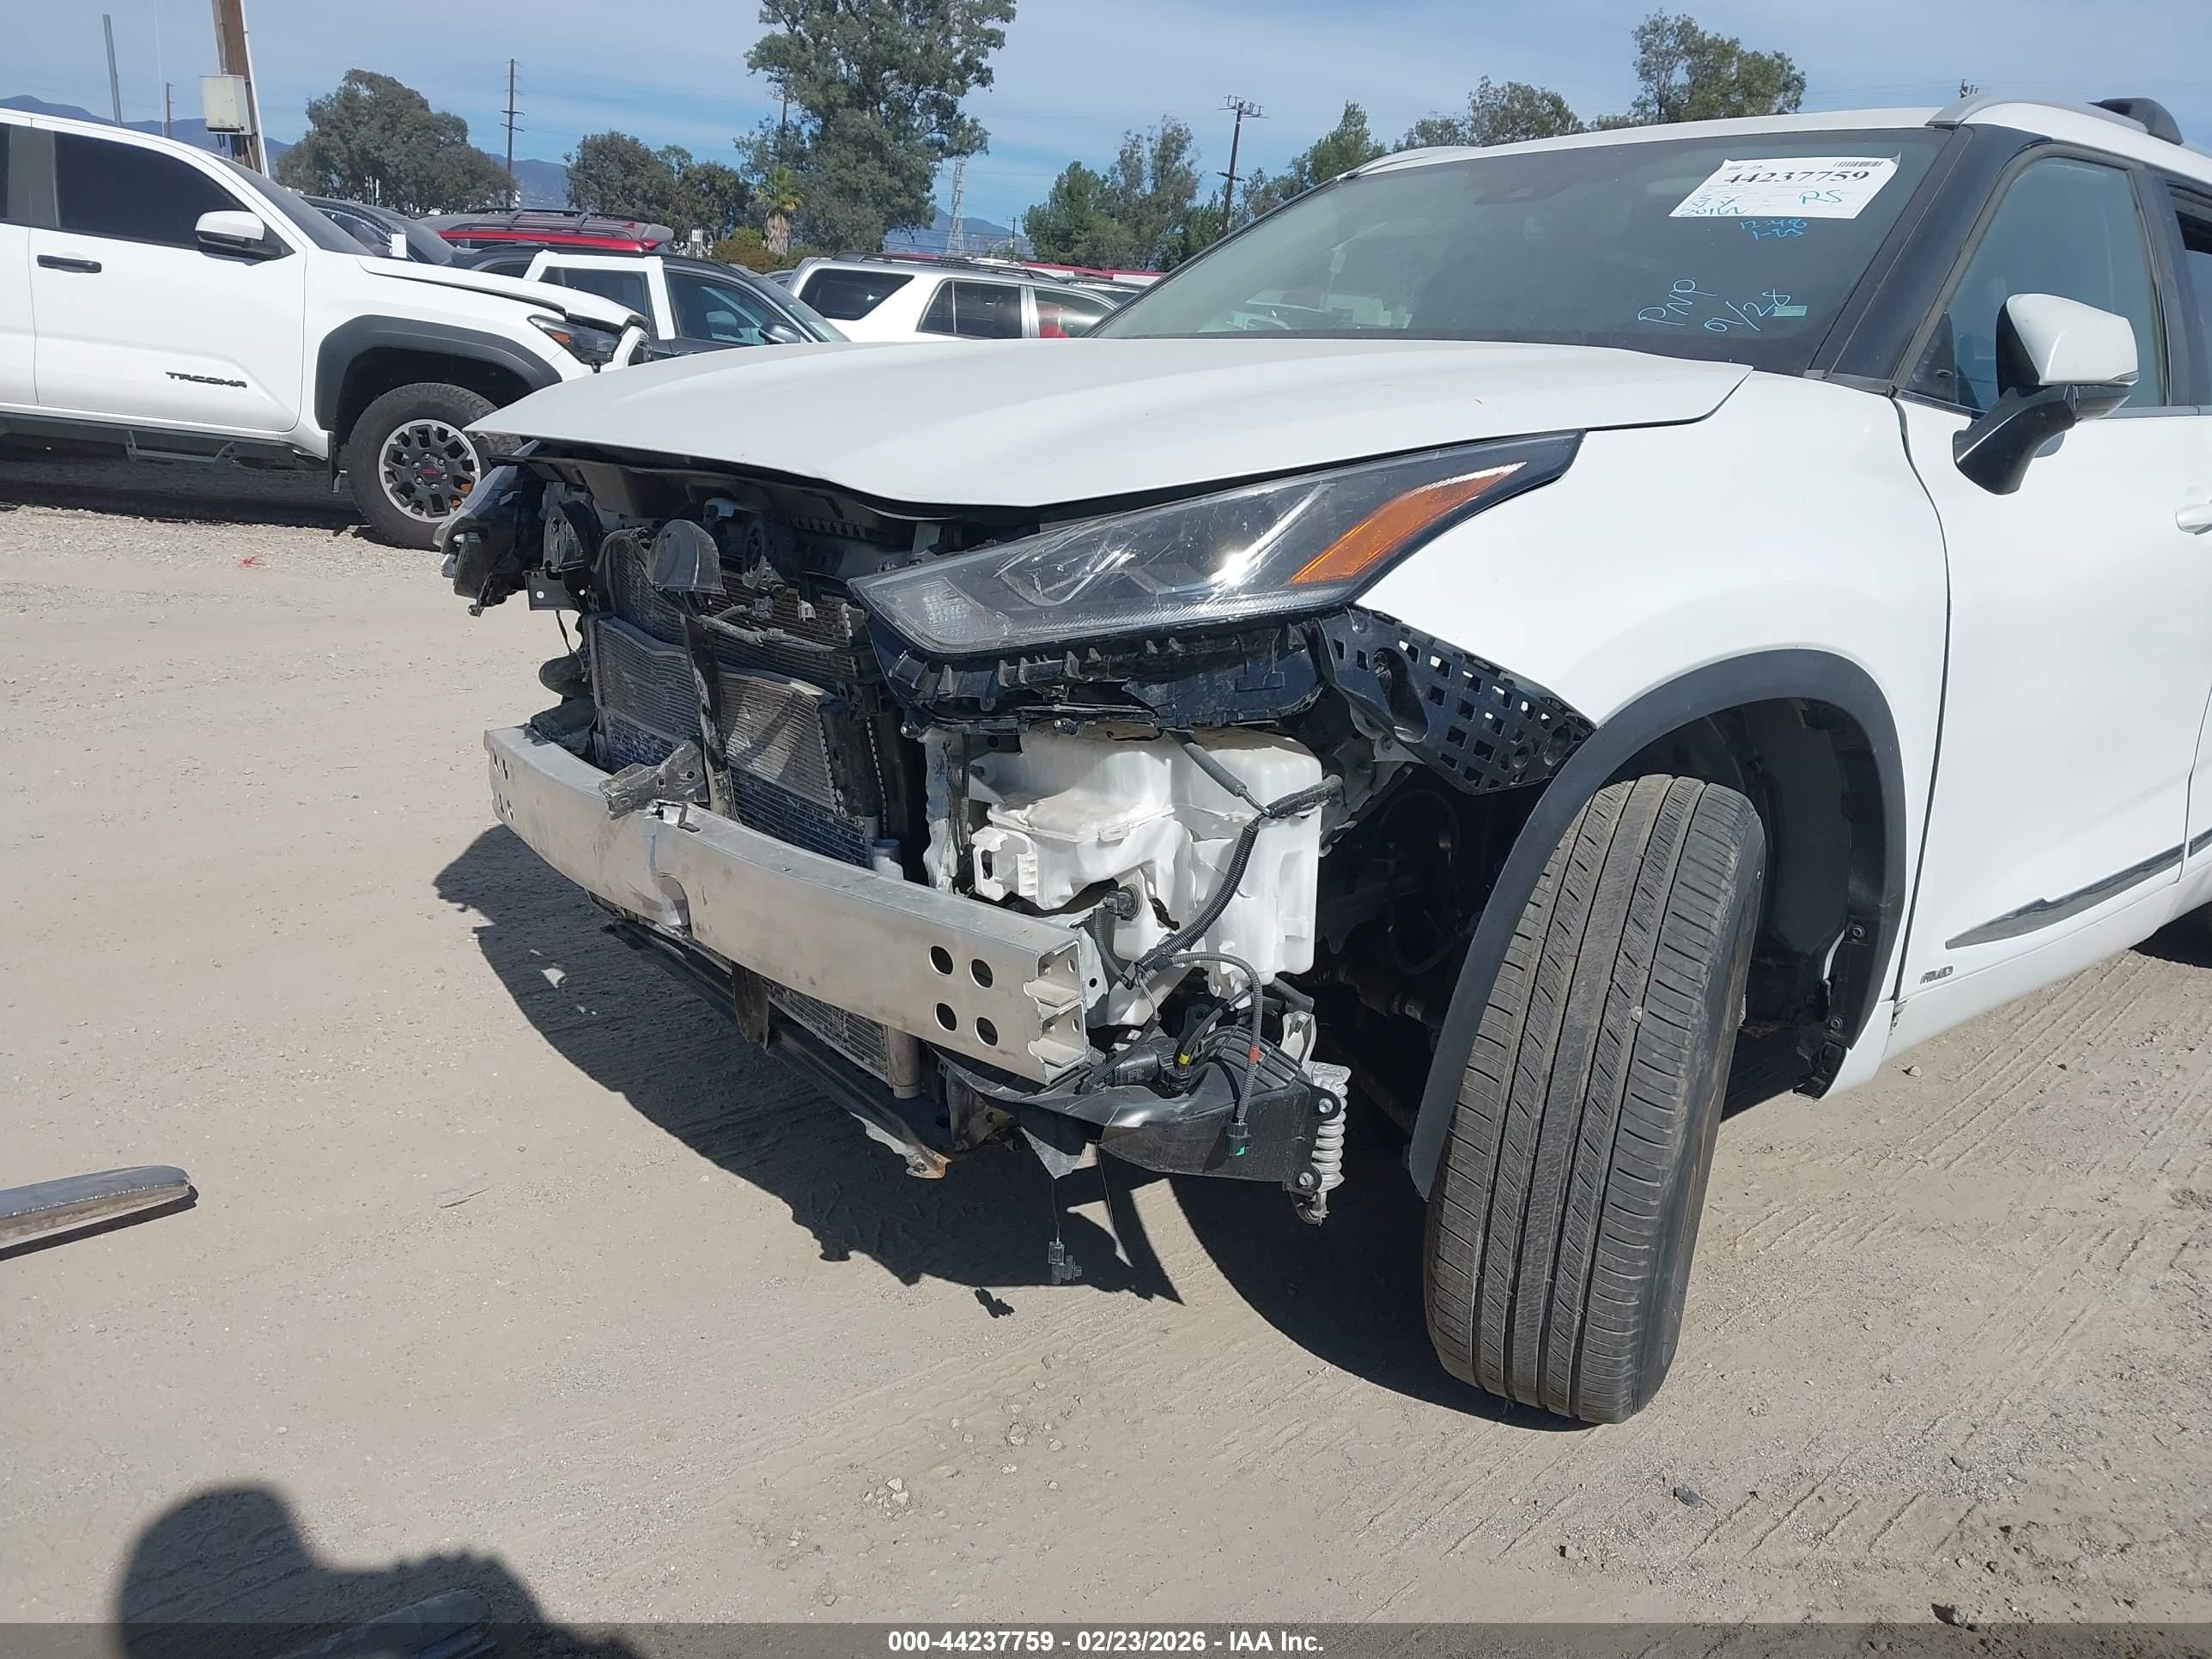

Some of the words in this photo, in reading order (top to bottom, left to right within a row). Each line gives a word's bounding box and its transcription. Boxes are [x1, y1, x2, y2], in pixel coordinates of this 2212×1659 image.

[1724, 170, 1870, 183] 44237759
[1799, 189, 1843, 205] RS
[165, 371, 247, 388] TACOMA
